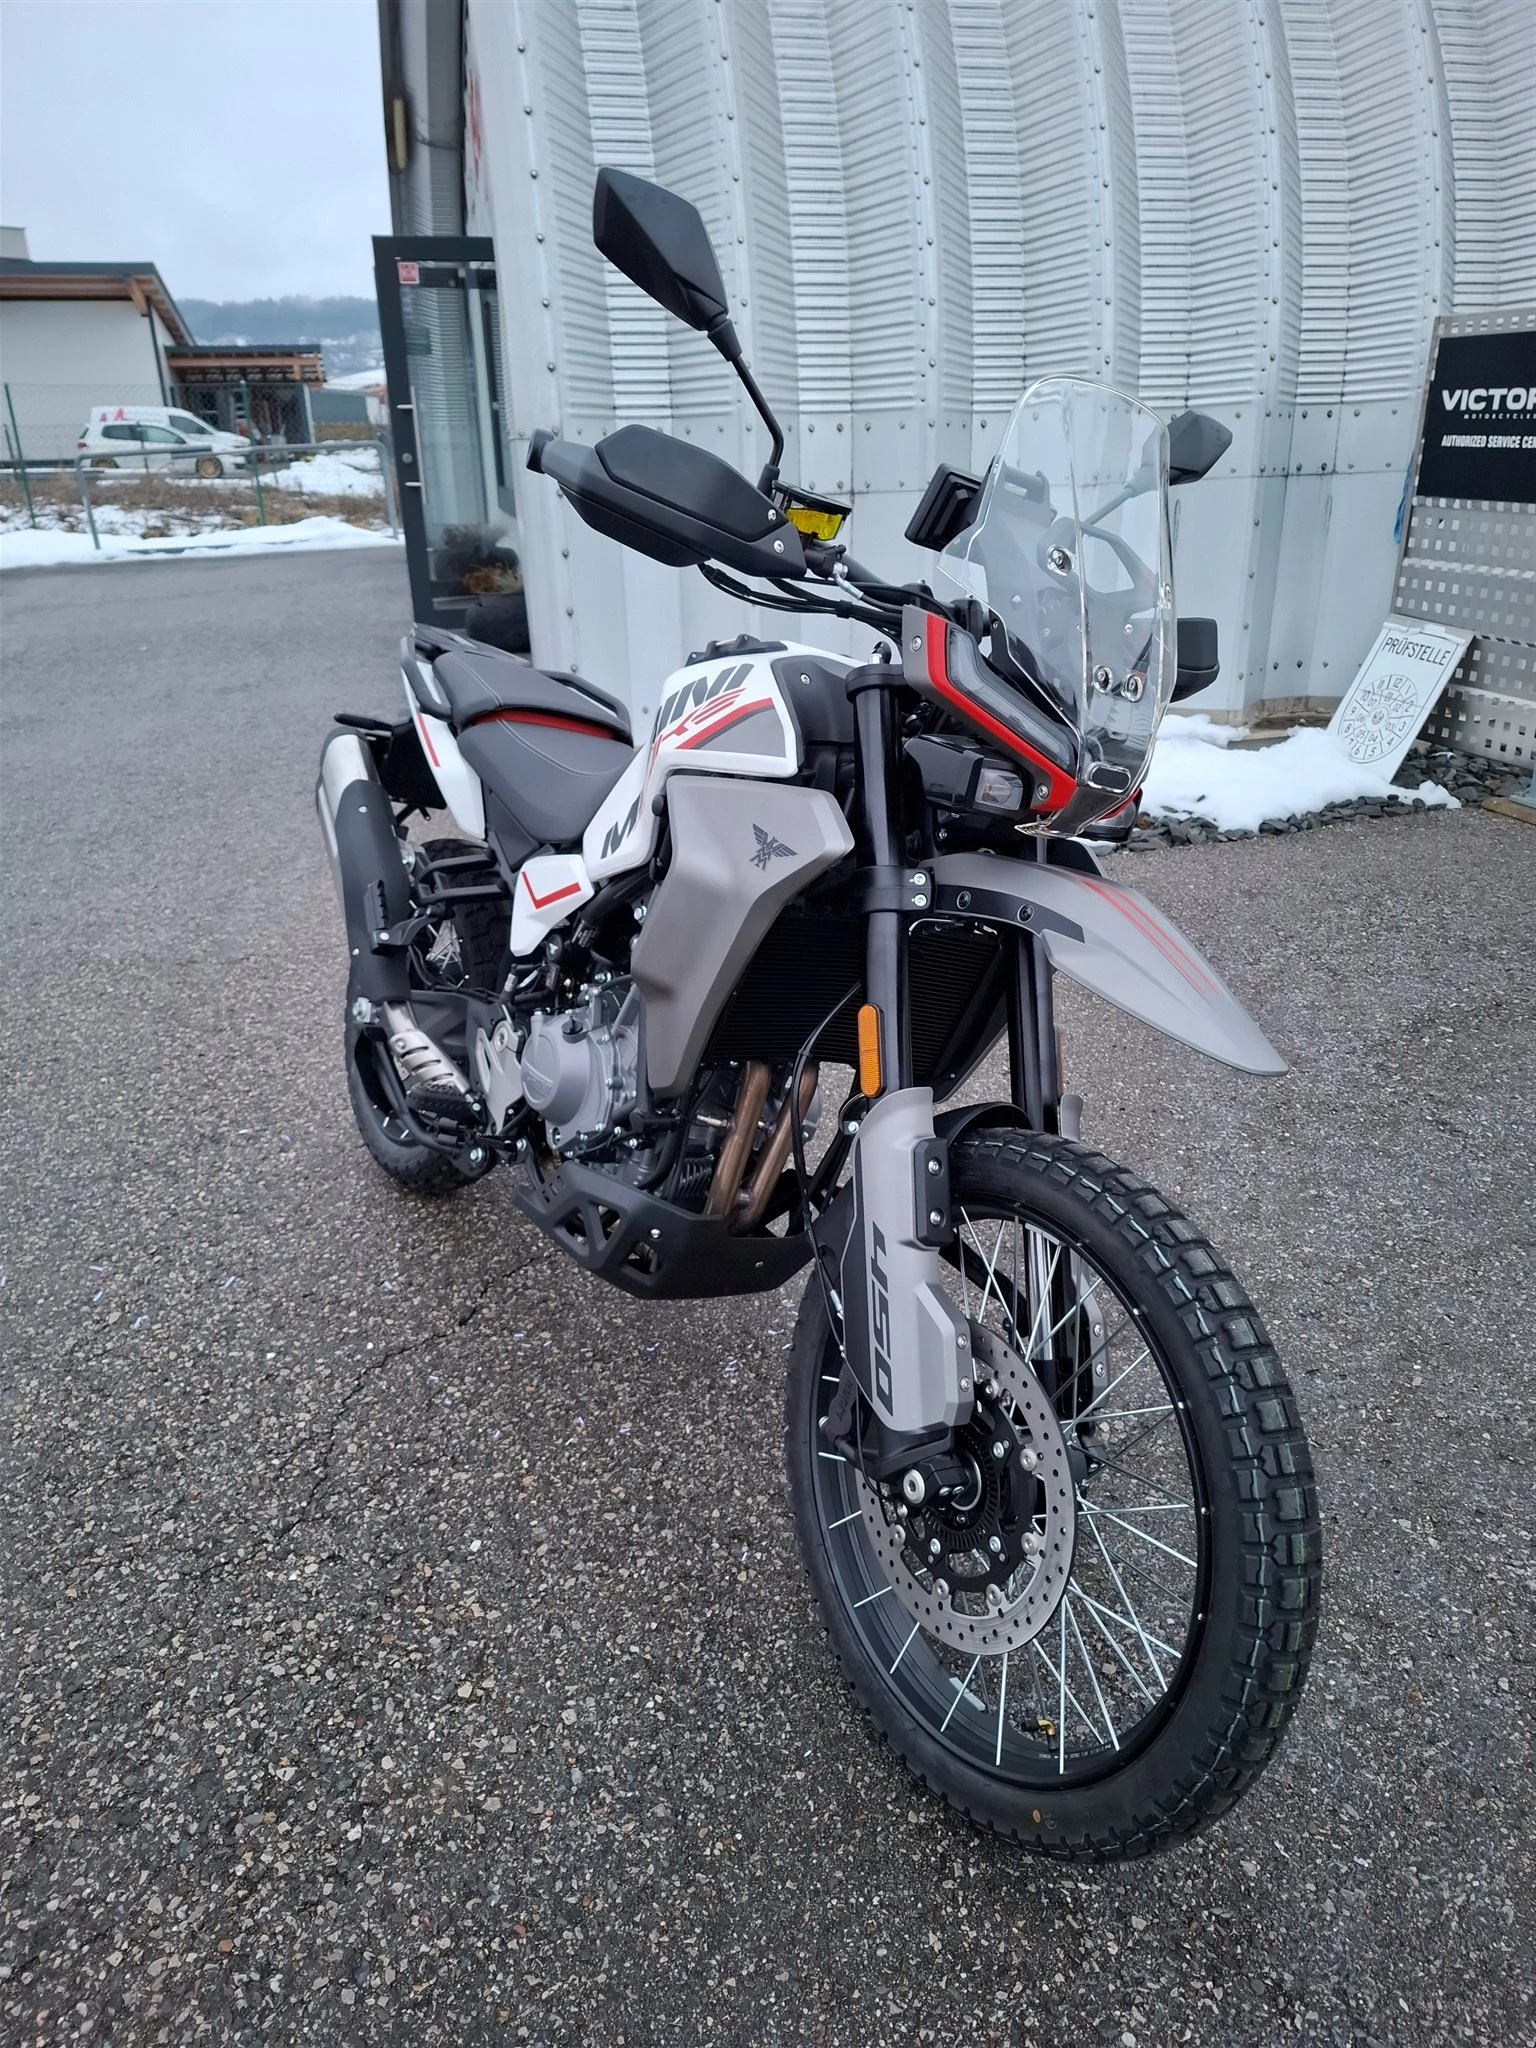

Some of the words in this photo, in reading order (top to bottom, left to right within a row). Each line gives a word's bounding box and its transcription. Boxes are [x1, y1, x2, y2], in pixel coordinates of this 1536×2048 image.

[1441, 434, 1487, 448] AUTHORIZED
[1487, 435, 1521, 448] SERVICE
[1381, 636, 1451, 666] PRÜFSTELLE
[1392, 677, 1403, 689] 12
[1405, 684, 1412, 695] 1
[1404, 700, 1414, 713] 2
[1398, 721, 1407, 732] 3
[1354, 745, 1361, 755] 6
[1368, 746, 1377, 757] 5
[600, 663, 755, 860] MINI
